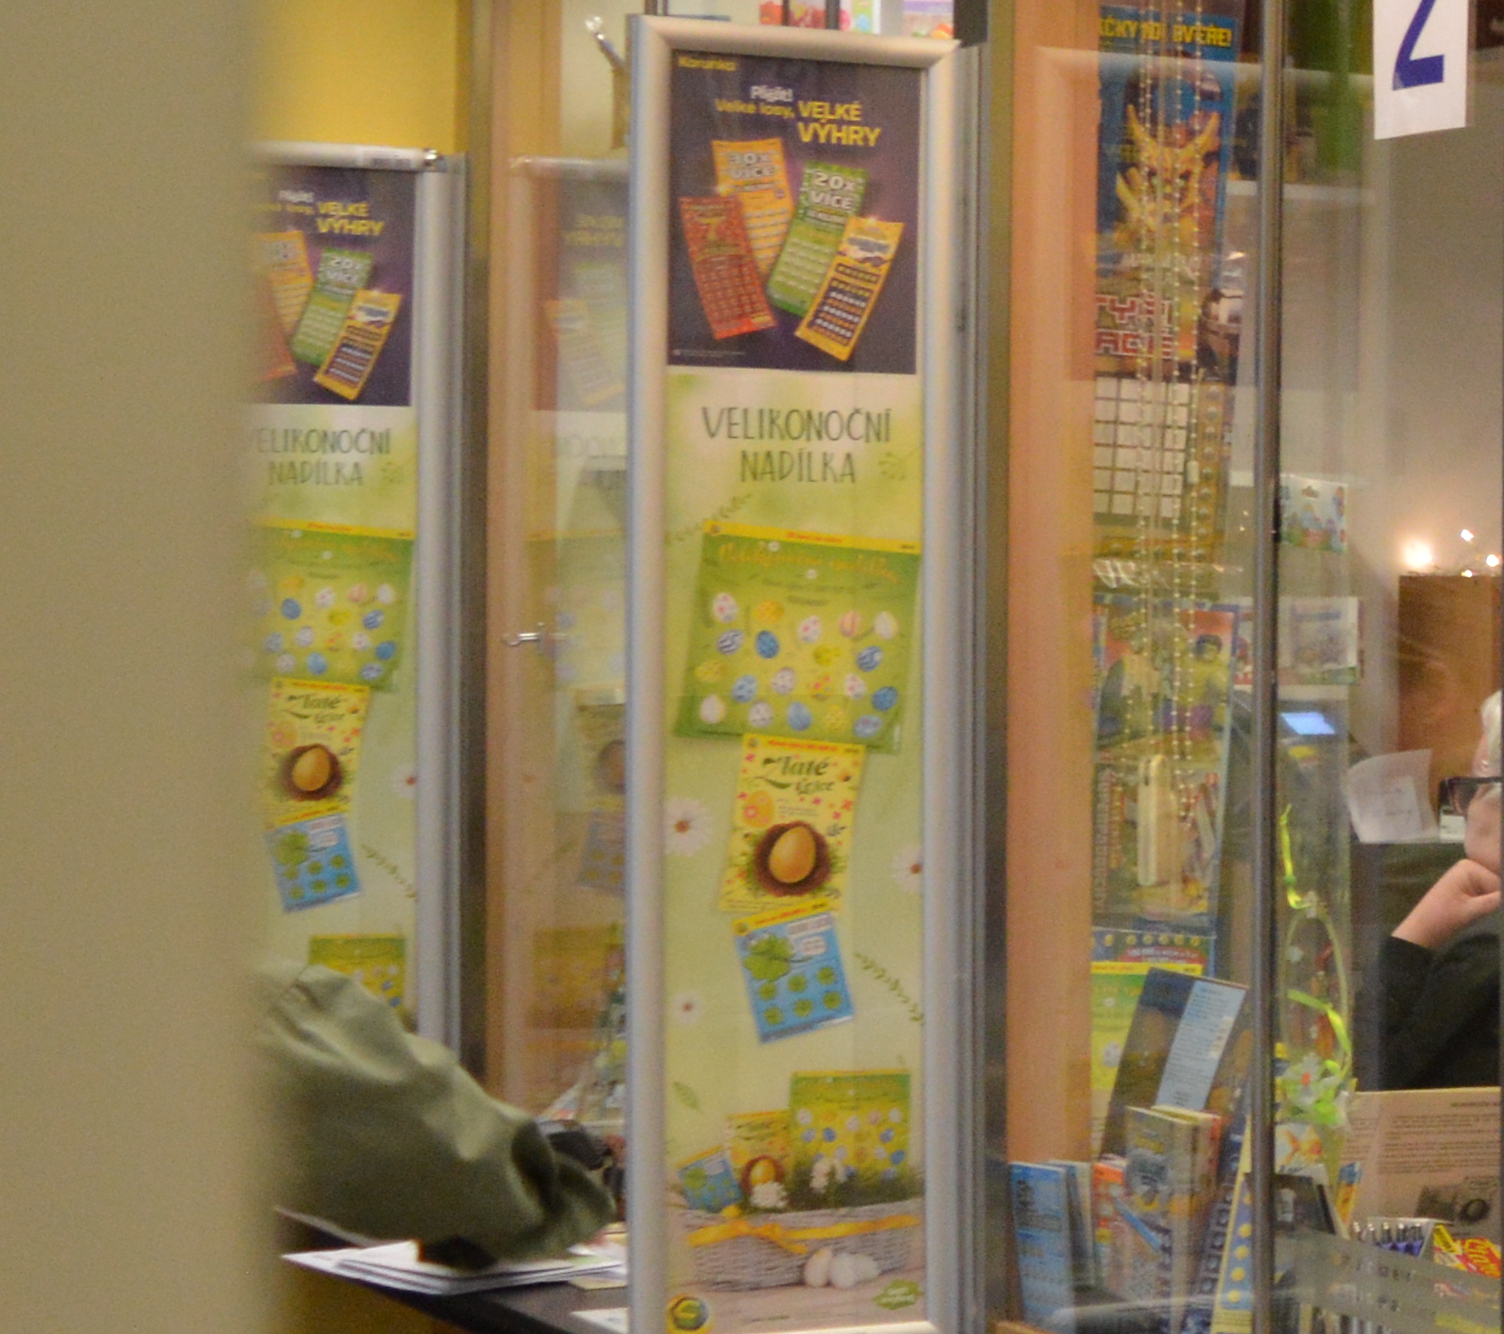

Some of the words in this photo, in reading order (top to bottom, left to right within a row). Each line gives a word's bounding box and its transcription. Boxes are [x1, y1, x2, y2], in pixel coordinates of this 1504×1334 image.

[798, 100, 863, 121] VELKÉ
[798, 118, 881, 147] VÝHRY
[316, 217, 385, 236] VÝHRY
[701, 406, 892, 443] VELIKONOČNÍ
[268, 458, 362, 486] NADÍLKA
[741, 447, 856, 483] NADÍLKA
